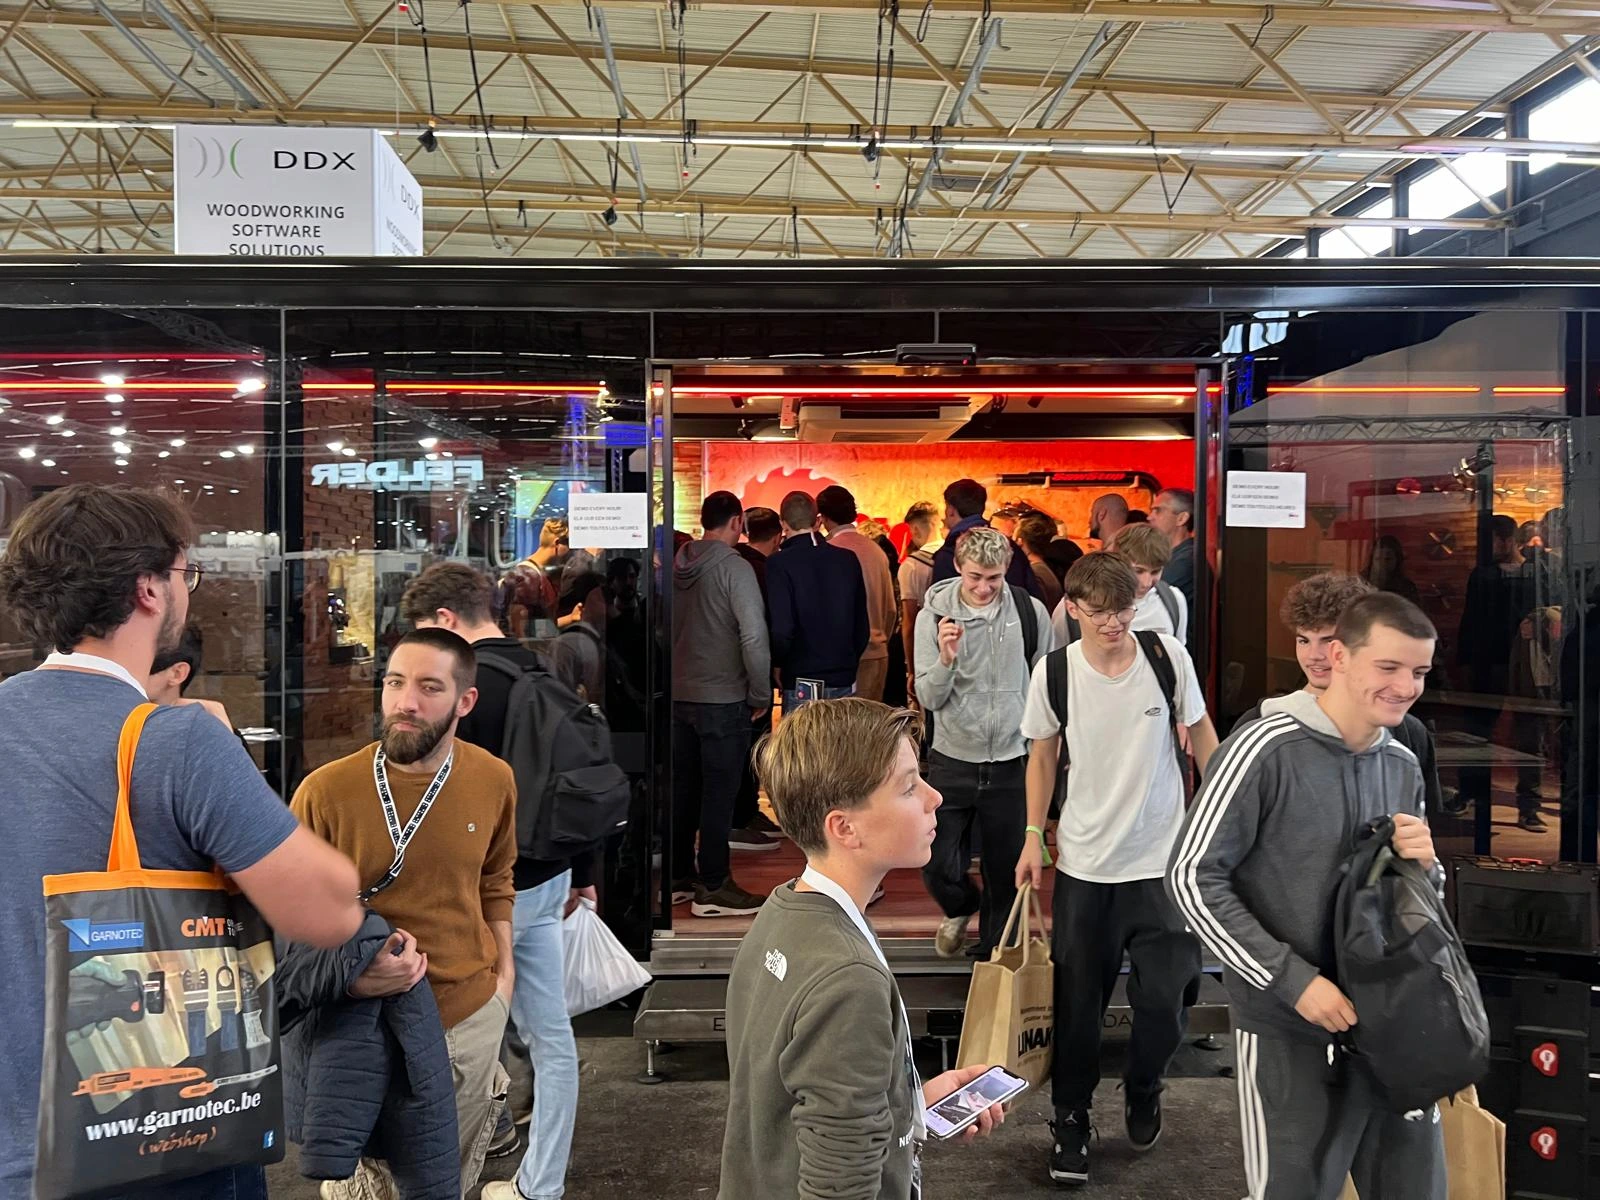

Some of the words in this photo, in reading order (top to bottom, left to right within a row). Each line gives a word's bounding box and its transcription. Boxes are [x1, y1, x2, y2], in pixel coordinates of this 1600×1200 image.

[274, 150, 356, 170] DDX
[207, 203, 345, 219] WOODWORKING
[232, 223, 321, 238] SOFTWARE
[229, 243, 325, 256] SOLUTIONS
[181, 917, 225, 938] CMT
[85, 1092, 261, 1140] www.garnotec.be
